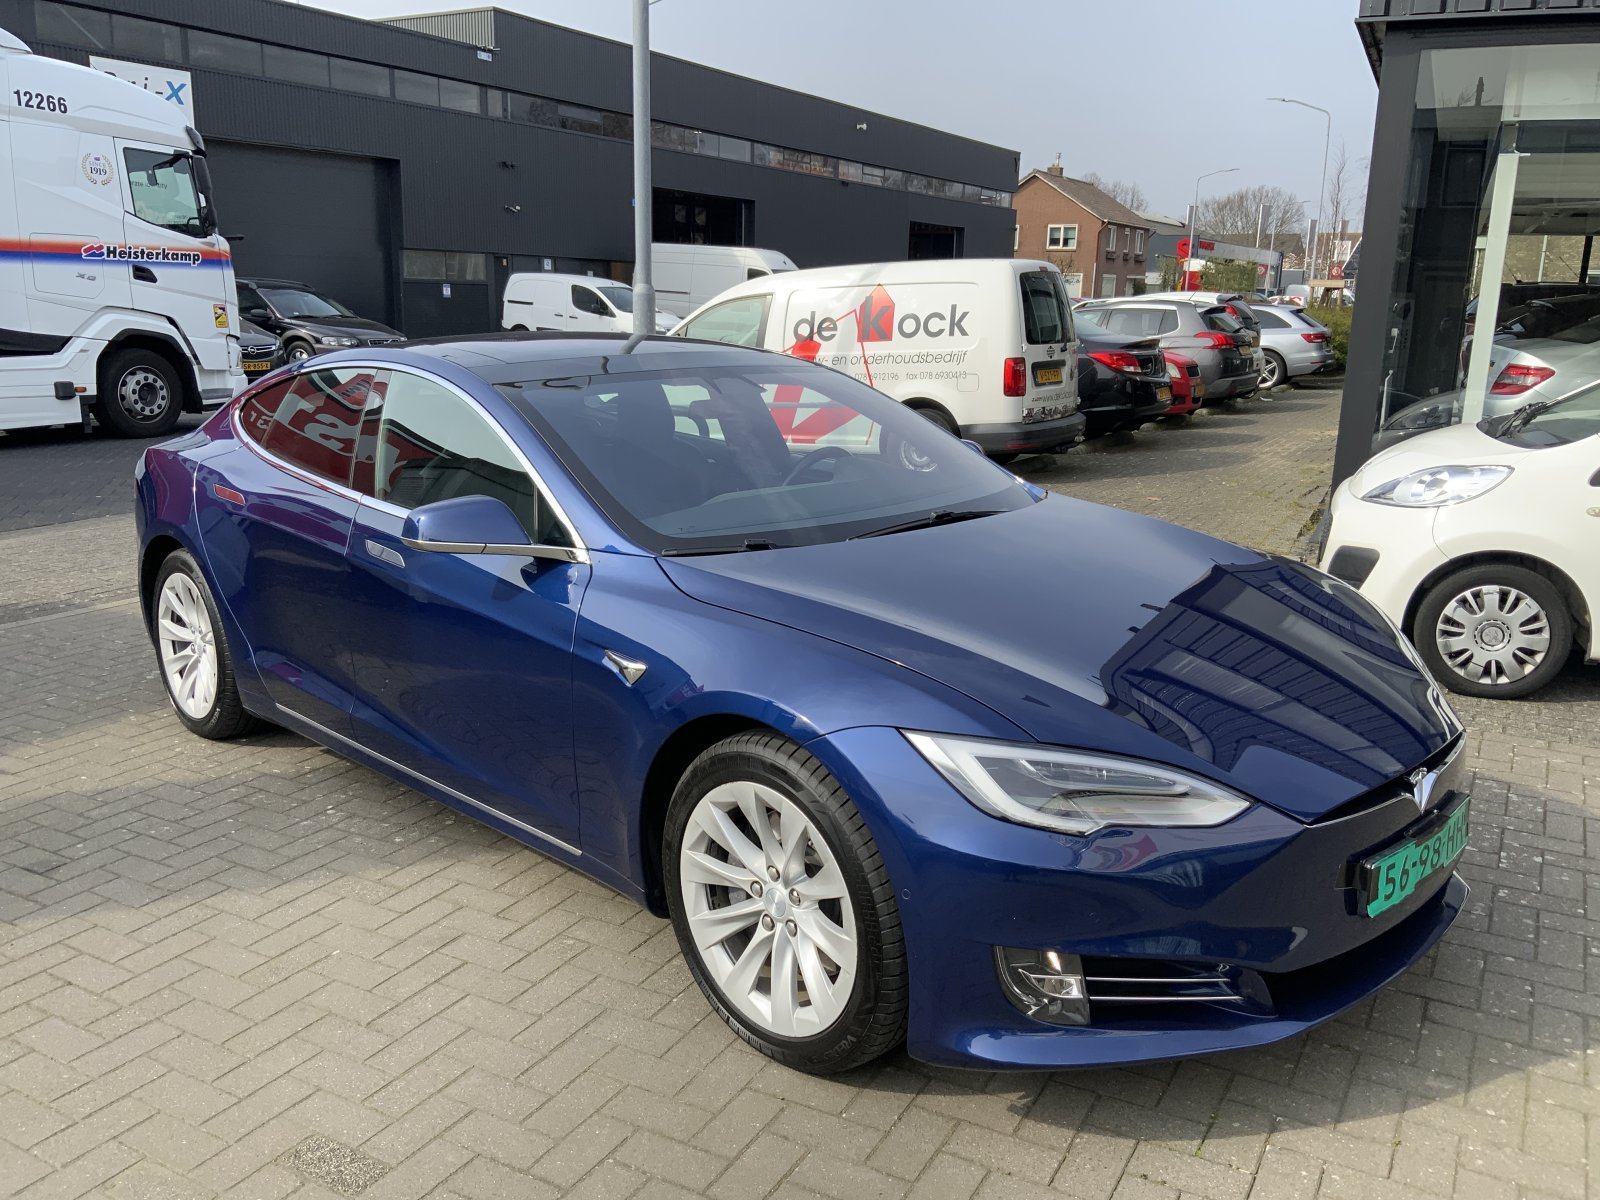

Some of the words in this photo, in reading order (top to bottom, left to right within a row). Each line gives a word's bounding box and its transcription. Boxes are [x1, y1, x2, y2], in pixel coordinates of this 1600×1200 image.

[13, 89, 68, 114] 12266
[89, 166, 107, 176] 1919
[106, 245, 201, 265] Heisterkamp
[793, 311, 838, 343] de
[831, 355, 847, 366] en
[850, 350, 967, 366] onderhoudsbedrijf
[919, 371, 933, 380] 078
